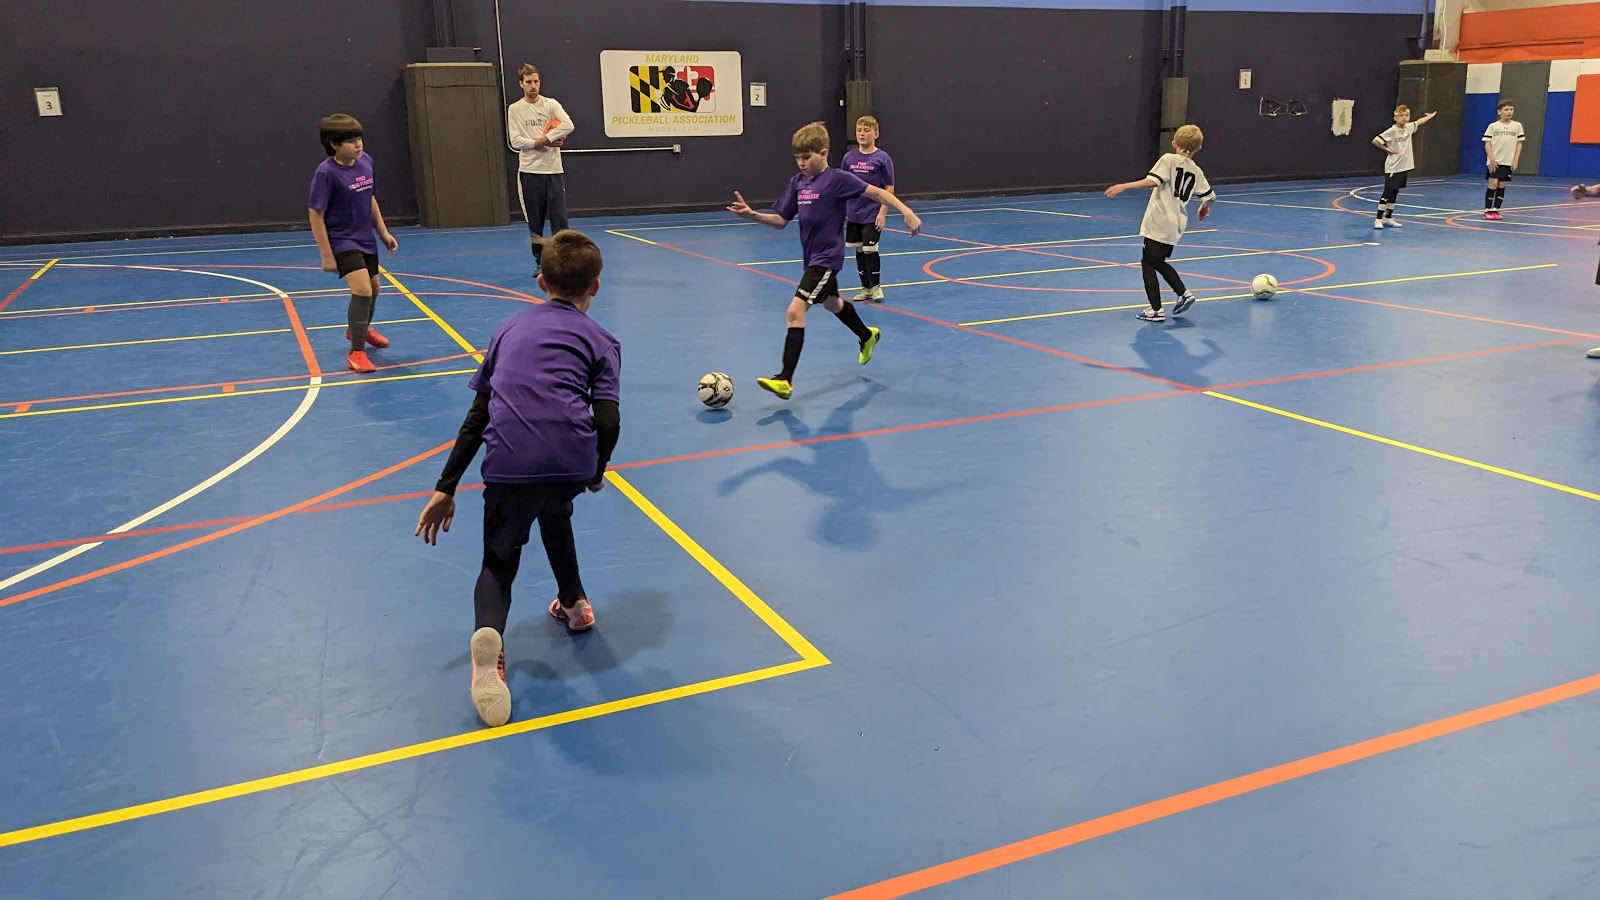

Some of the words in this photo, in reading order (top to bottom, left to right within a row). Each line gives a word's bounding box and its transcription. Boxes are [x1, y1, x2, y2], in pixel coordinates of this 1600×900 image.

[645, 54, 699, 64] MARYLAND
[46, 101, 53, 110] 3
[611, 115, 670, 125] PICKLEBALL
[673, 114, 736, 124] ASSOCIATION
[1174, 167, 1195, 202] 10
